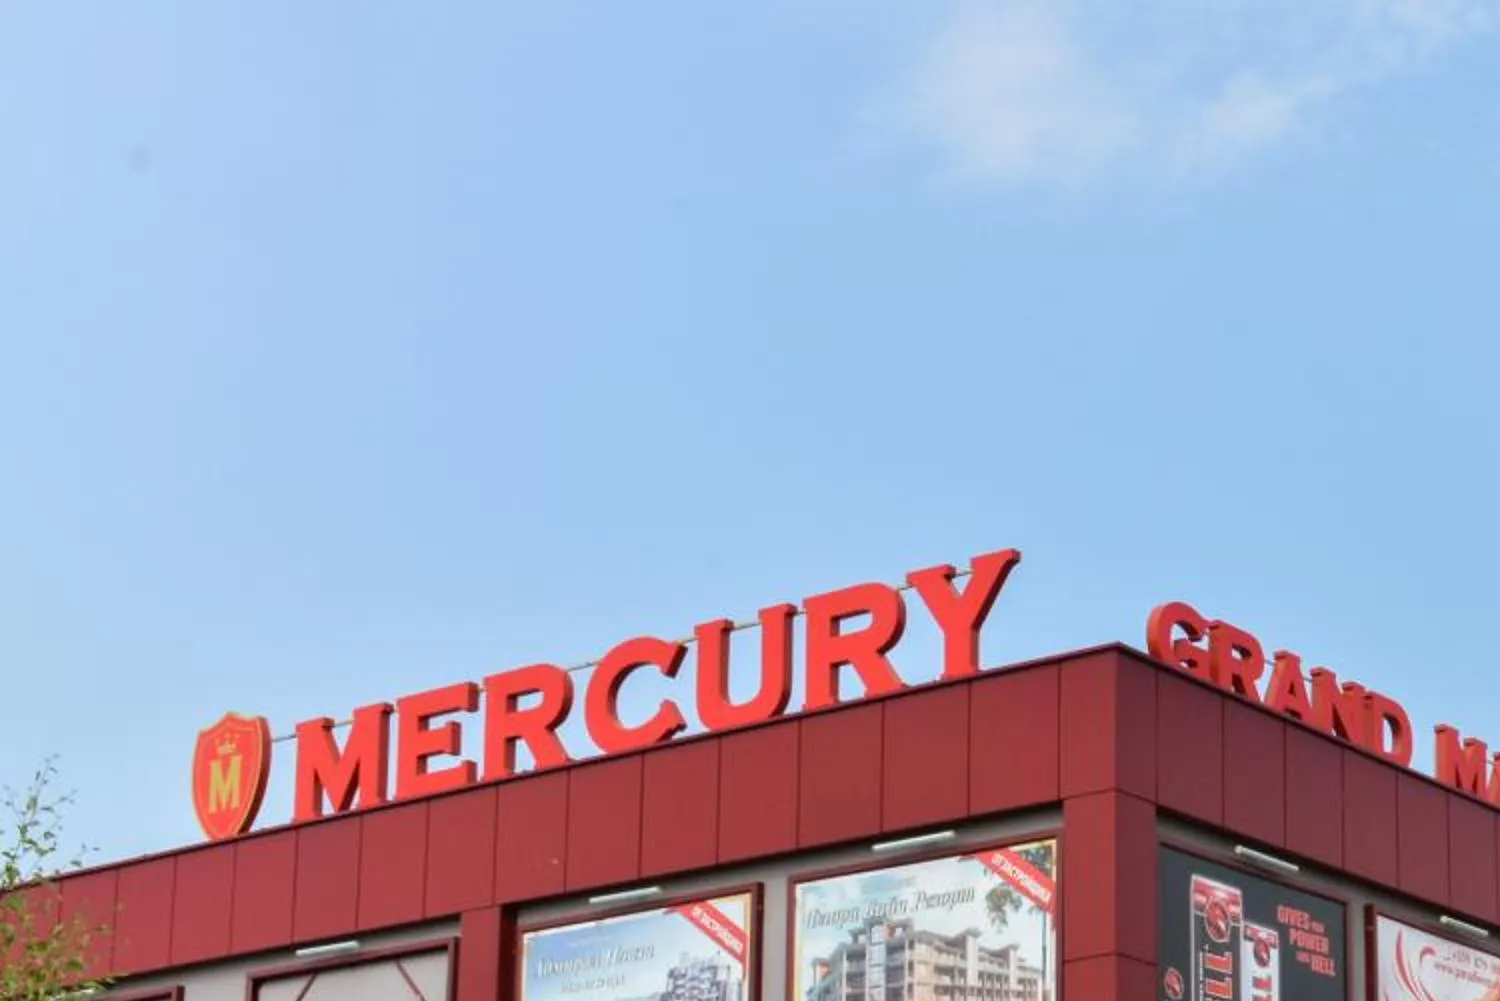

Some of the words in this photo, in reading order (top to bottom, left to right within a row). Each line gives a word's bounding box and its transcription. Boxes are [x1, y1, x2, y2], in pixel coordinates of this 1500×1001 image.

[293, 548, 1023, 823] MERCURY
[1147, 601, 1413, 769] GRAND
[208, 758, 241, 813] M
